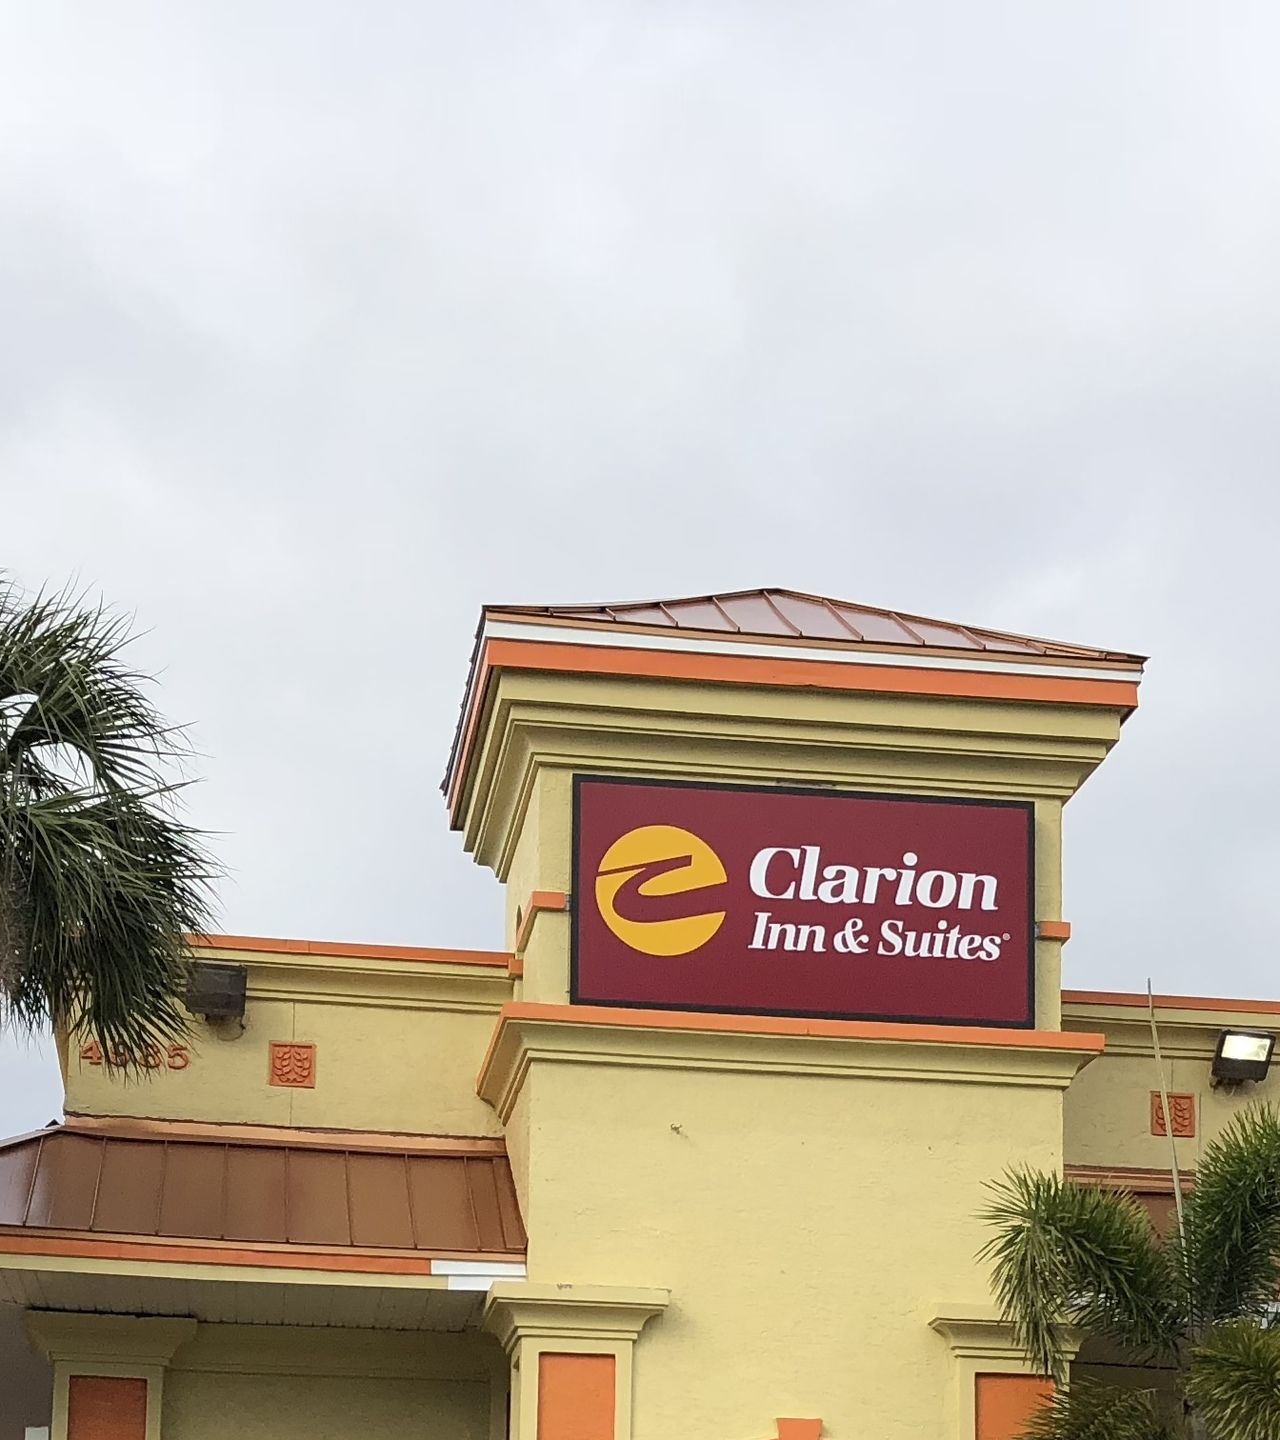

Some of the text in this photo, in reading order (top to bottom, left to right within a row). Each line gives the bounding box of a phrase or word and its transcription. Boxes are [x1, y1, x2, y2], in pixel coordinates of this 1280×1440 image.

[749, 845, 999, 911] Clarion
[747, 911, 1002, 961] Inn & Suites
